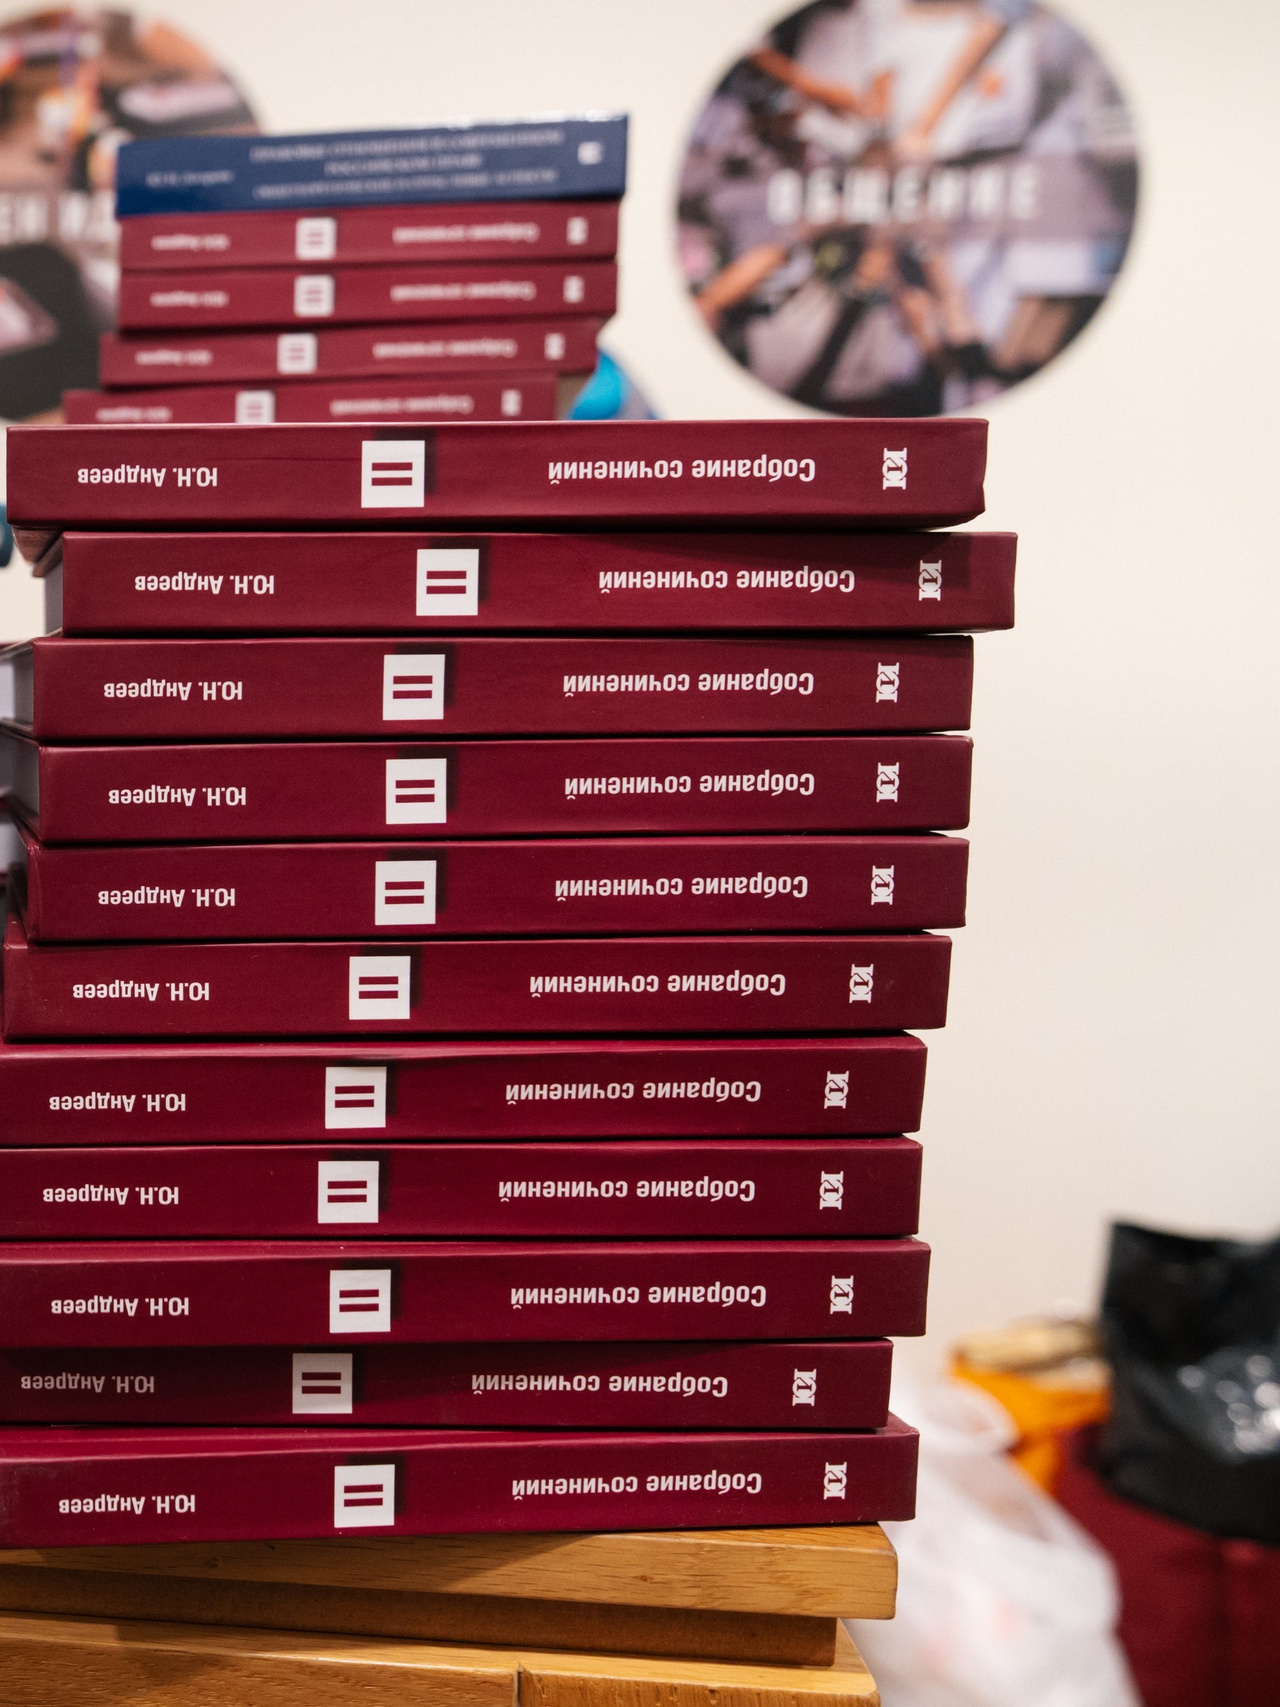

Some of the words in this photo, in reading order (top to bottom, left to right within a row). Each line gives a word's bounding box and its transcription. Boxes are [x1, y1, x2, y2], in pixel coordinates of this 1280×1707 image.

[78, 464, 166, 487] Андреев
[173, 467, 217, 487] Ю.Н.
[549, 460, 682, 484] сочинений
[692, 454, 815, 482] Собрание
[135, 571, 223, 594] Андреев
[230, 575, 274, 594] Ю.Н.
[599, 571, 727, 593] сочинений
[737, 566, 854, 592] Собрание
[104, 679, 192, 700] Андреев
[199, 681, 242, 700] Ю.Н.
[564, 674, 689, 697] сочинений
[698, 669, 813, 695] Собрание
[565, 776, 691, 799] сочинений
[700, 770, 814, 796] Собрание
[109, 785, 196, 806] Андреев
[202, 787, 246, 806] Ю.Н.
[556, 878, 682, 901] сочинений
[692, 872, 807, 898] Собрание
[98, 886, 185, 907] Андреев
[192, 888, 235, 906] Ю.Н.
[73, 980, 159, 1001] Андреев
[166, 982, 209, 1001] Ю.Н.
[530, 975, 658, 997] сочинений
[668, 970, 785, 996] Собрание
[506, 1083, 634, 1104] сочинений
[643, 1078, 761, 1102] Собрание
[50, 1092, 135, 1112] Андреев
[142, 1094, 185, 1111] Ю.Н.
[43, 1184, 129, 1205] Андреев
[136, 1187, 178, 1204] Ю.Н.
[499, 1181, 627, 1201] сочинений
[637, 1176, 755, 1201] Собрание
[511, 1287, 639, 1308] сочинений
[649, 1282, 766, 1307] Собрание
[51, 1296, 138, 1316] Андреев
[145, 1298, 188, 1315] Ю.Н.
[21, 1373, 104, 1393] Андреев
[111, 1376, 154, 1393] Ю.Н.
[473, 1376, 599, 1397] сочинений
[609, 1372, 727, 1397] Собрание
[513, 1477, 637, 1500] сочинений
[647, 1470, 761, 1494] Собрание
[59, 1494, 145, 1514] Андреев
[152, 1495, 195, 1513] Ю.Н.
